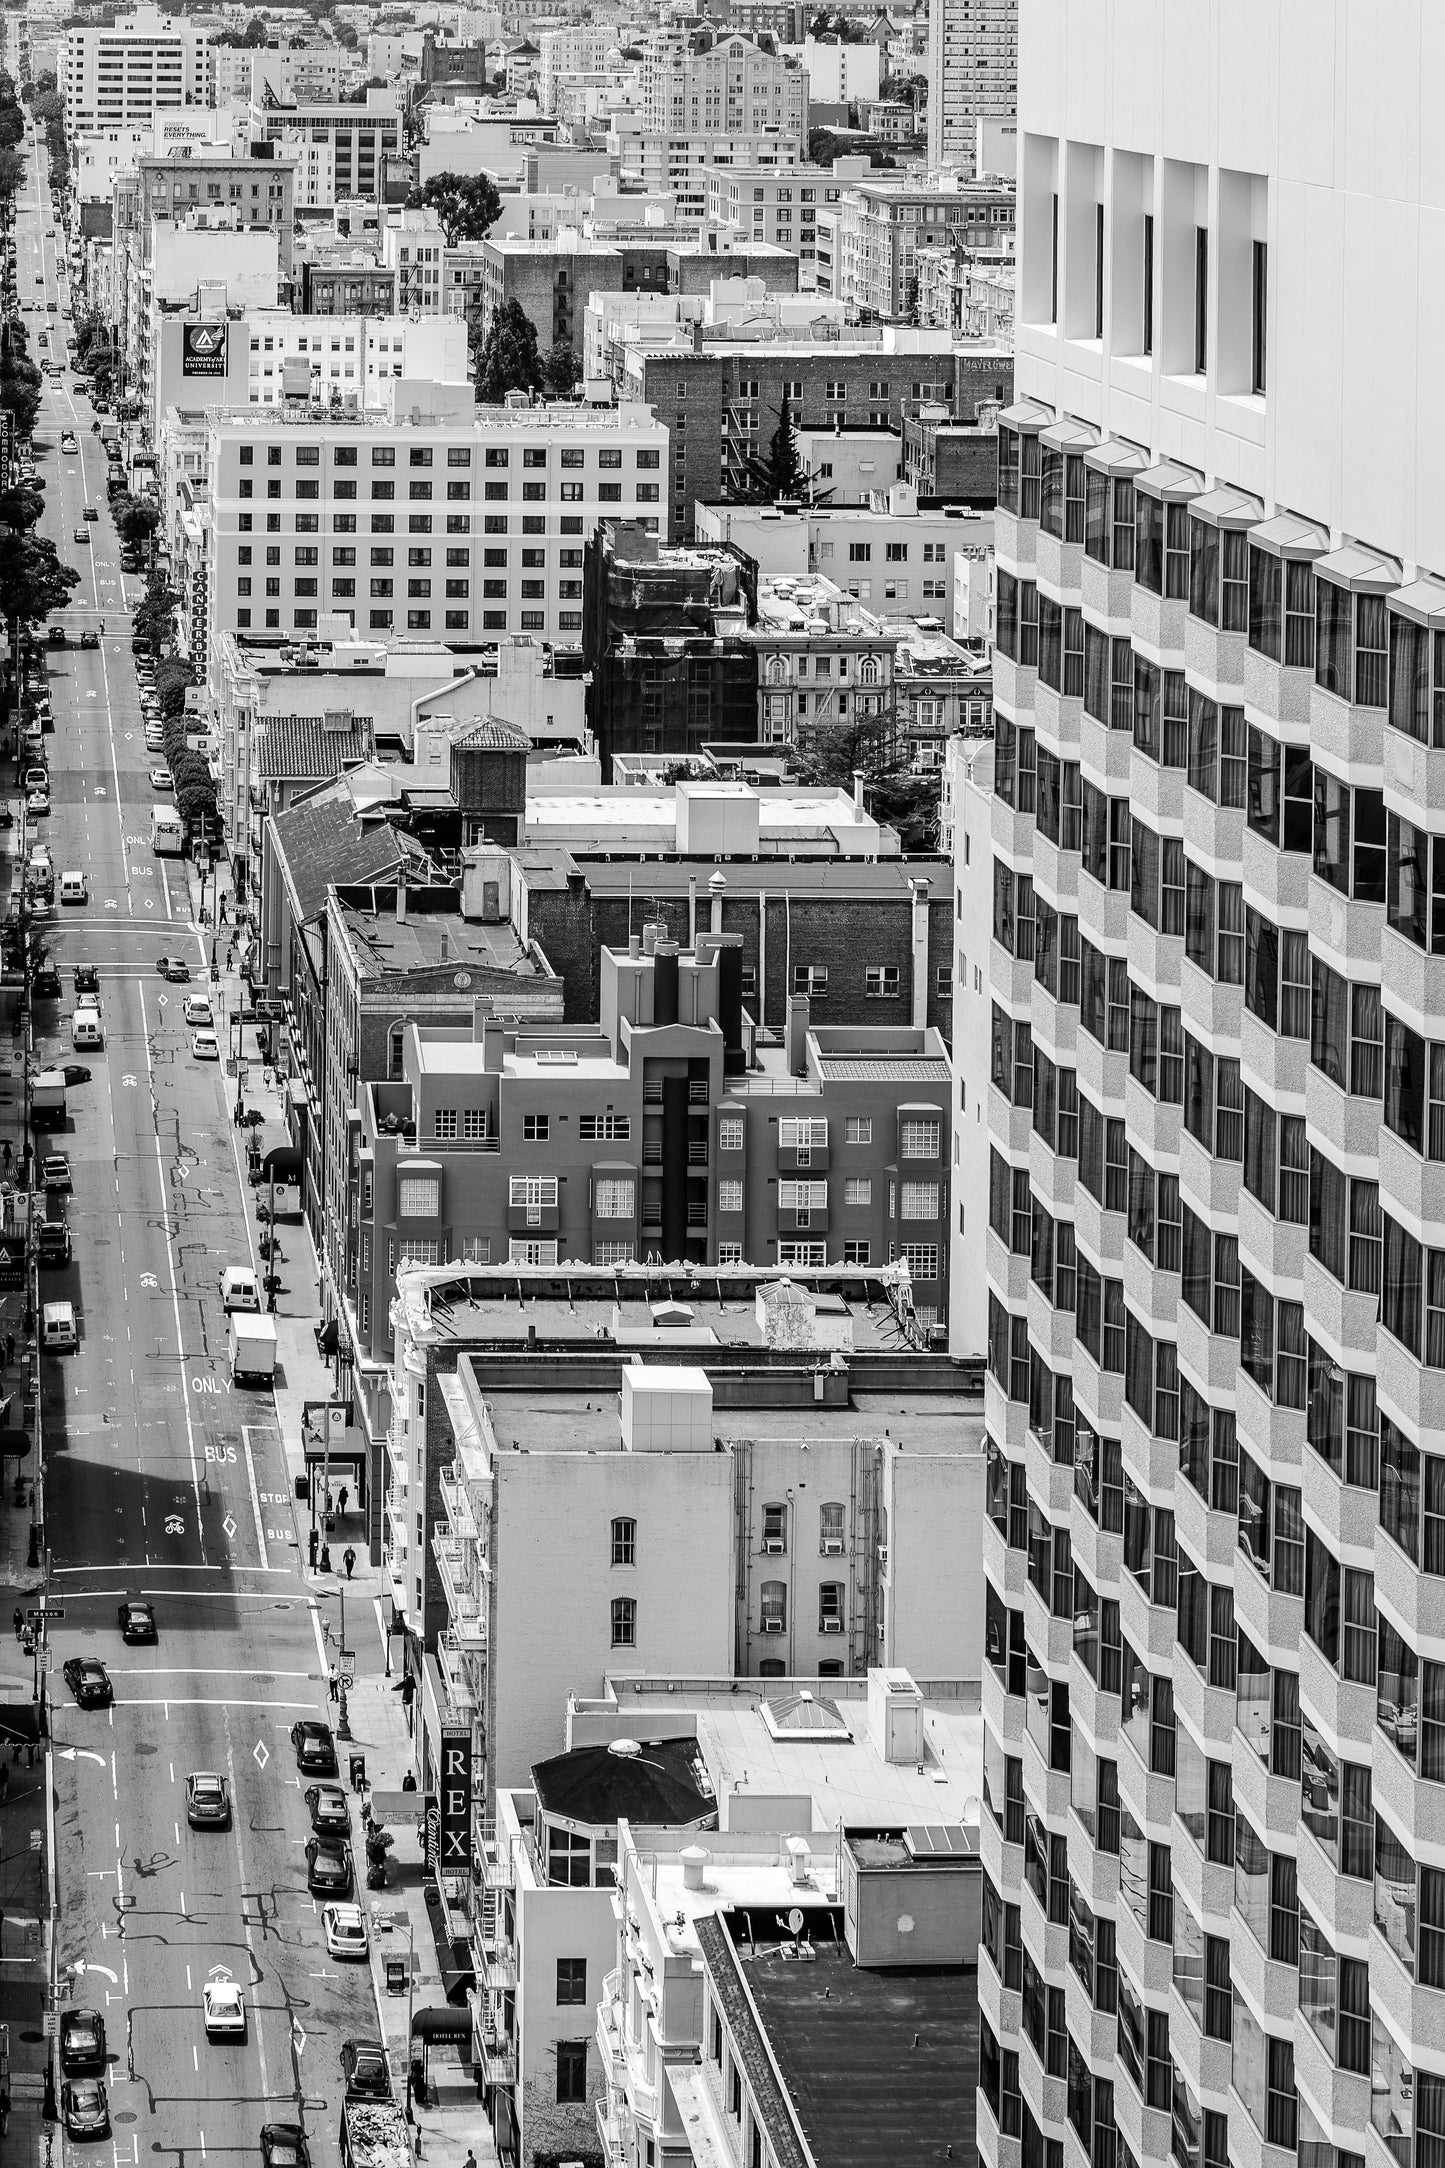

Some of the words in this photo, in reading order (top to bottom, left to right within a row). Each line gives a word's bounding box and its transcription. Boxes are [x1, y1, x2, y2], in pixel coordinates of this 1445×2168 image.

[193, 571, 208, 686] CANTERBURY
[157, 826, 180, 834] FedEx
[126, 836, 154, 845] ONLY
[131, 867, 153, 876] BUS
[287, 1174, 296, 1182] M
[192, 1377, 233, 1394] ONLY
[204, 1445, 238, 1464] BUS
[267, 1529, 292, 1540] BUS
[445, 1749, 468, 1857] REX
